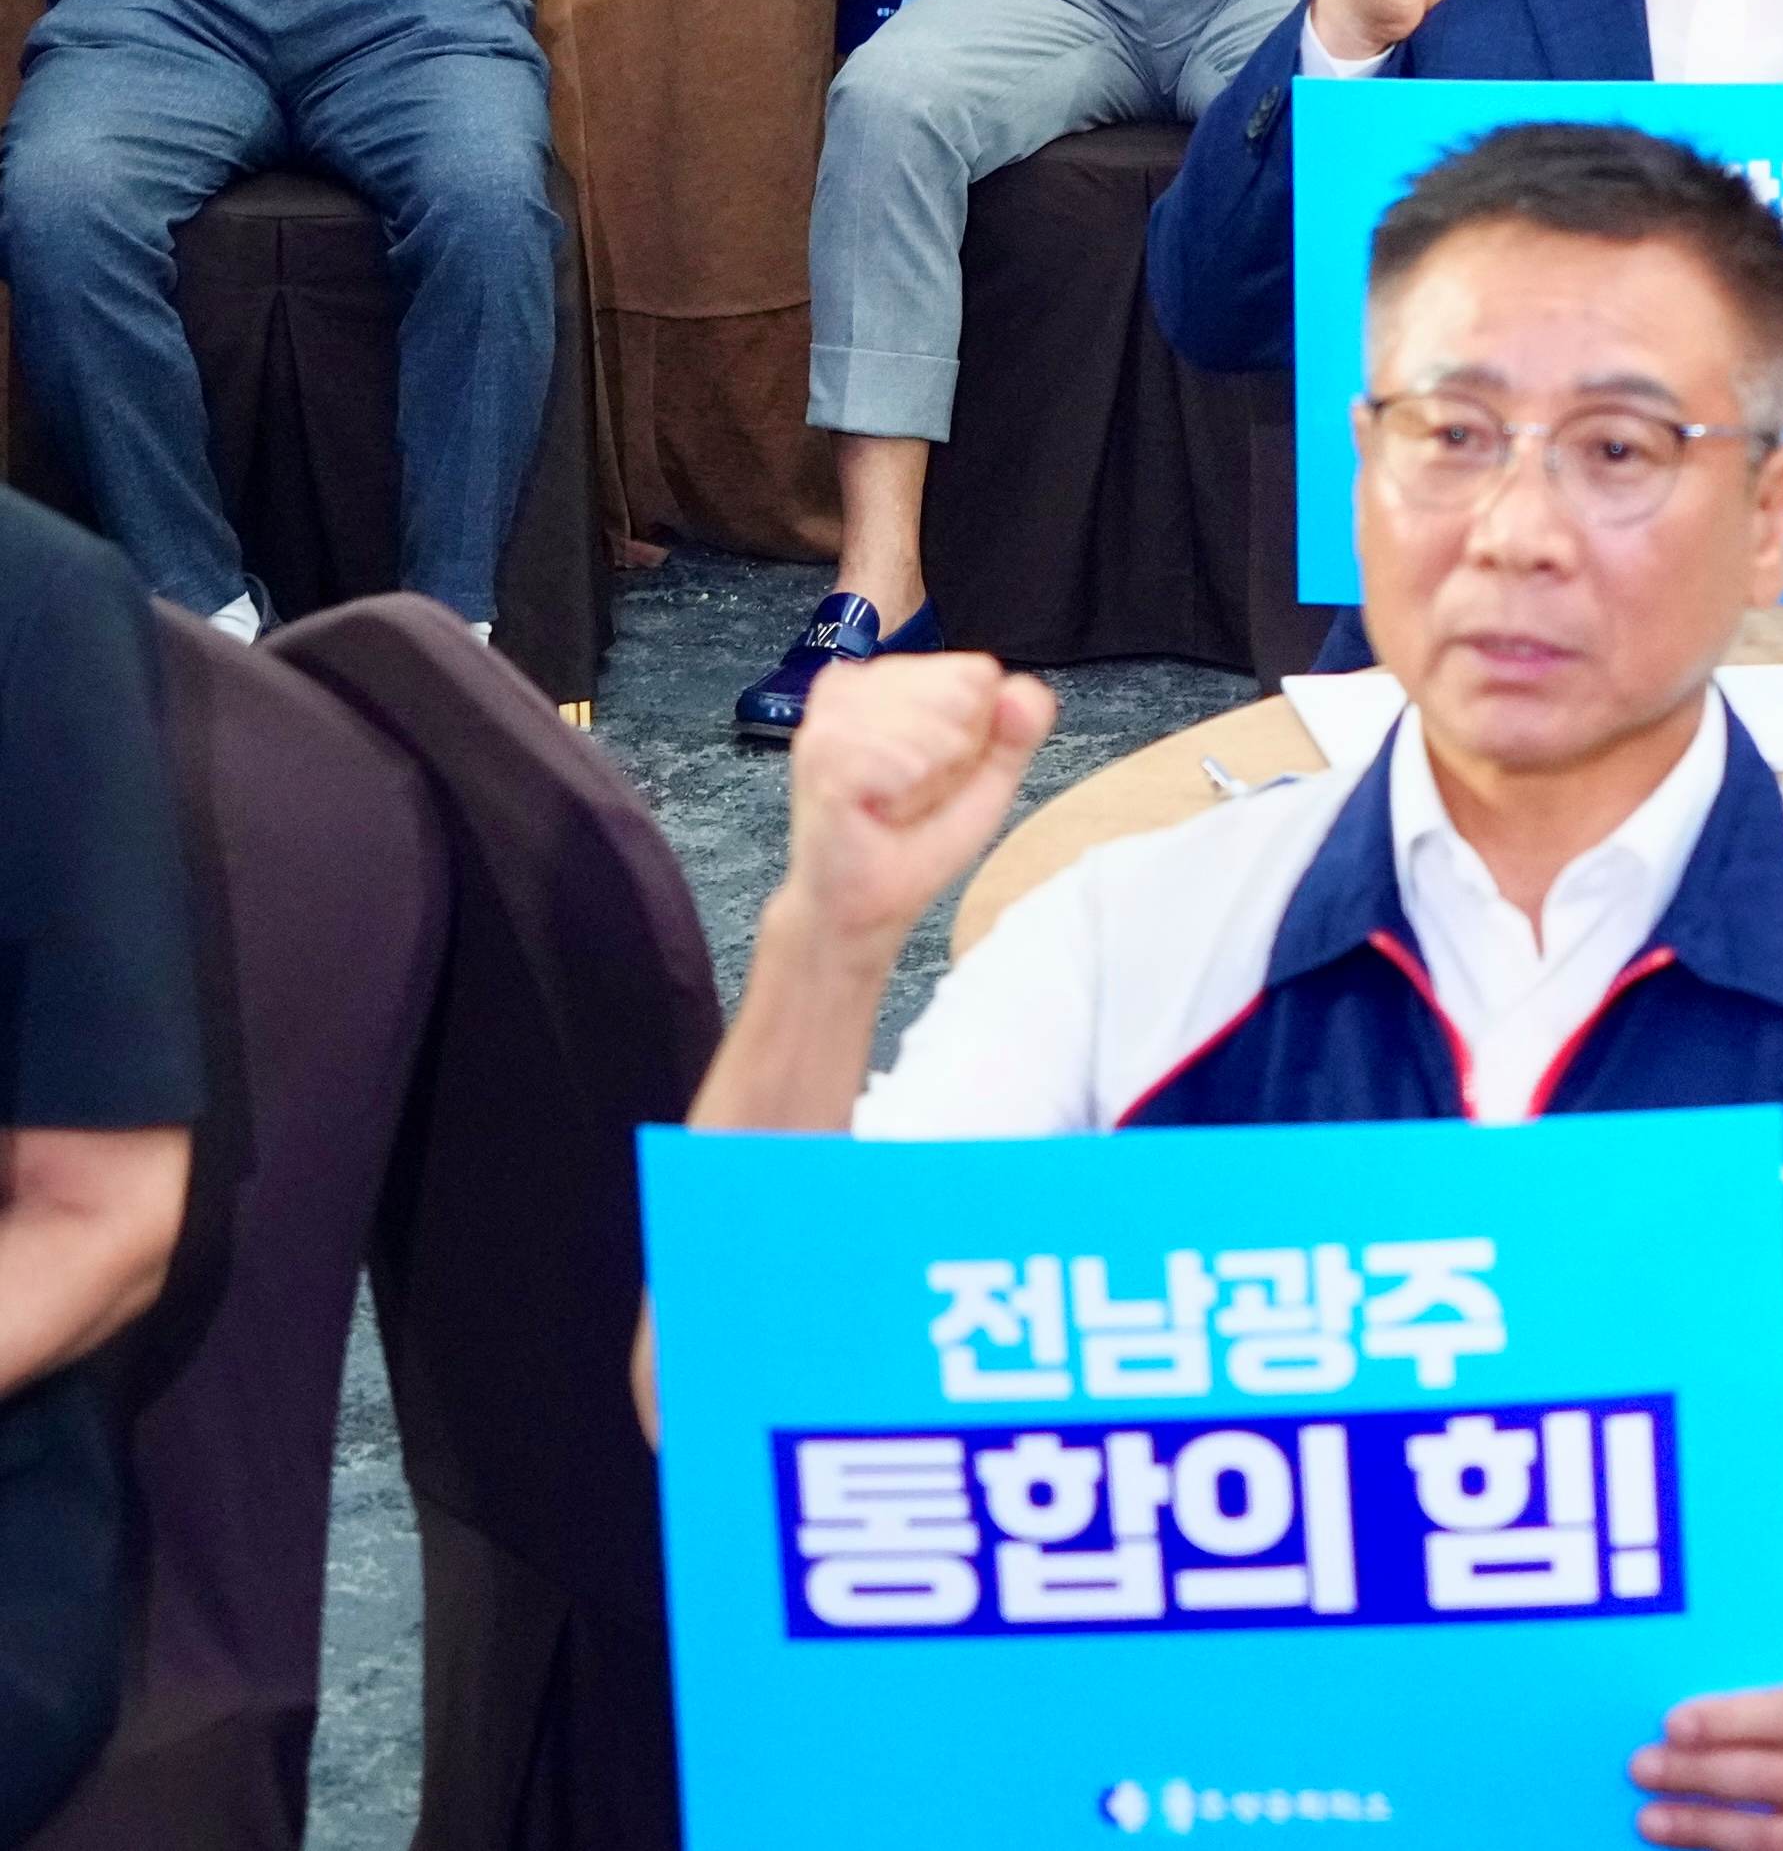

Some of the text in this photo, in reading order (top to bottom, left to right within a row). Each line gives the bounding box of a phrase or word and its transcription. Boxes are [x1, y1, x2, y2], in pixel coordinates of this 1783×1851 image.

[927, 1235, 1507, 1402] 전남광주
[796, 1409, 1664, 1631] 통합의 힘!
